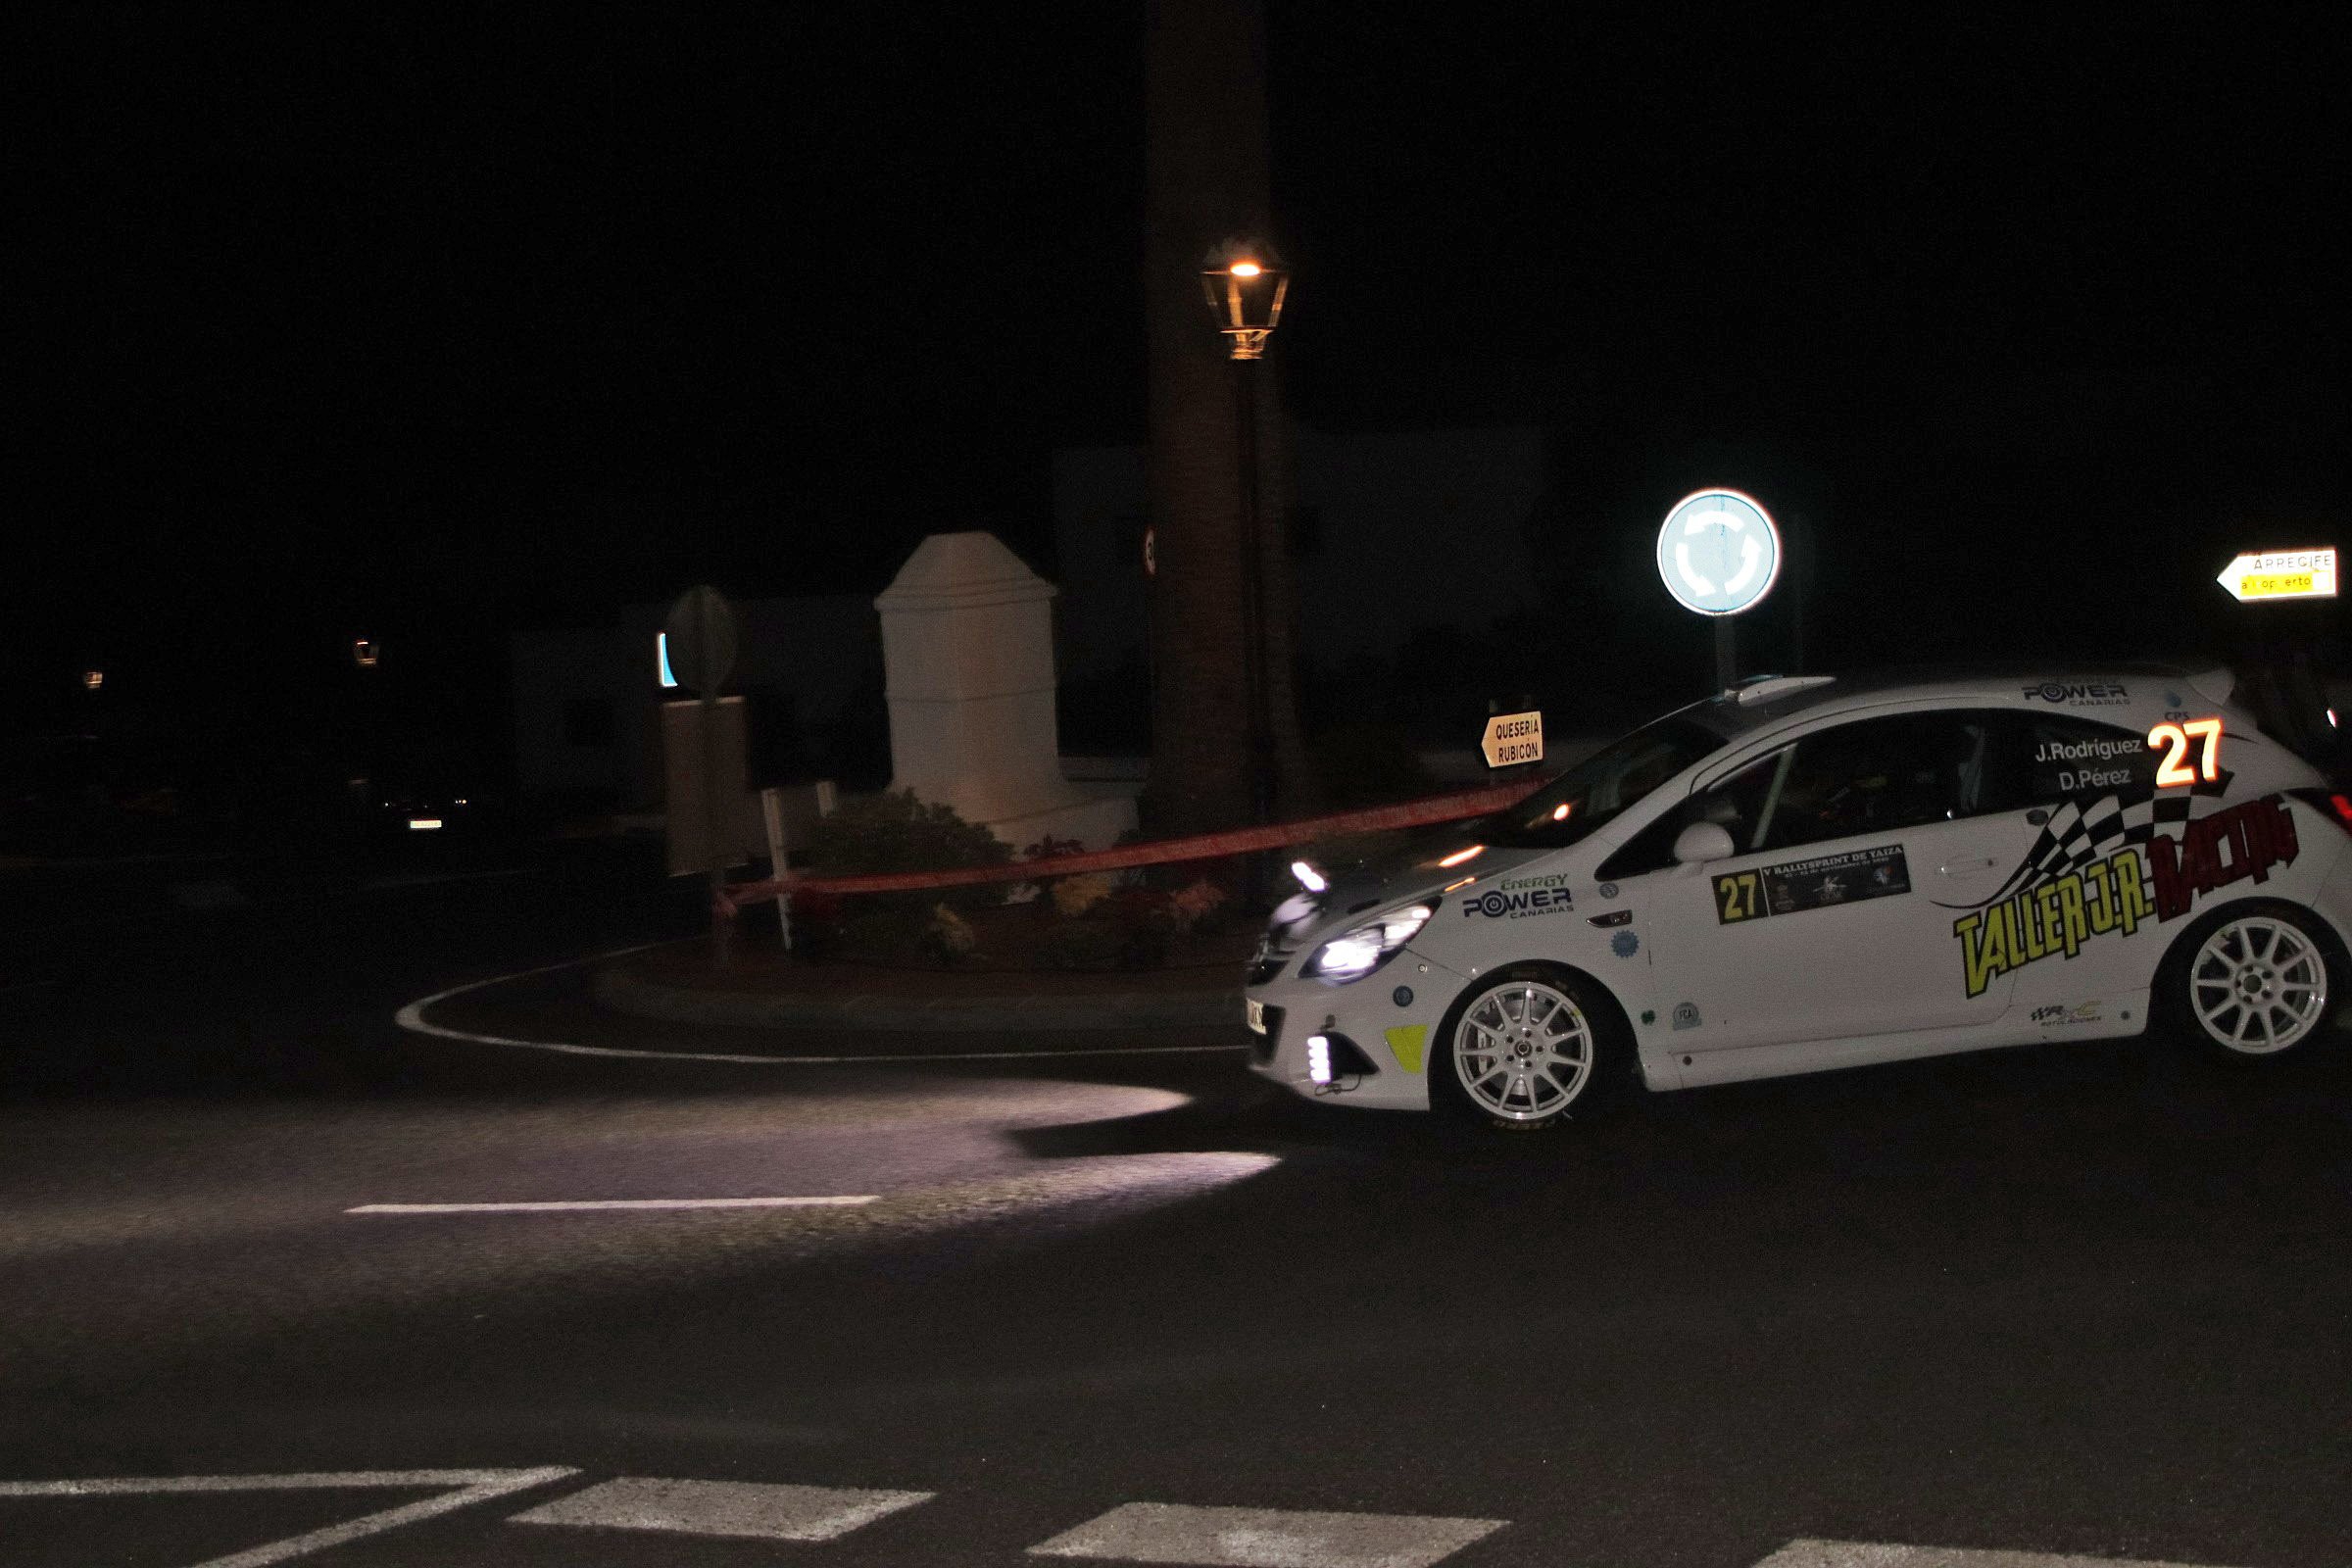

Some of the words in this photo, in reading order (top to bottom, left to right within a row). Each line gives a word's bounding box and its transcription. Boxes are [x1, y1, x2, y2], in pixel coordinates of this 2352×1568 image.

[1495, 713, 1540, 741] QUESERÍA
[1498, 737, 1539, 762] RUBICÓN
[2147, 718, 2222, 789] 27
[2059, 767, 2132, 791] D.Pérez
[1462, 887, 1572, 917] POWER
[1720, 874, 1756, 919] 27
[1510, 906, 1574, 918] CANARIAS
[1953, 872, 2091, 999] TALLER
